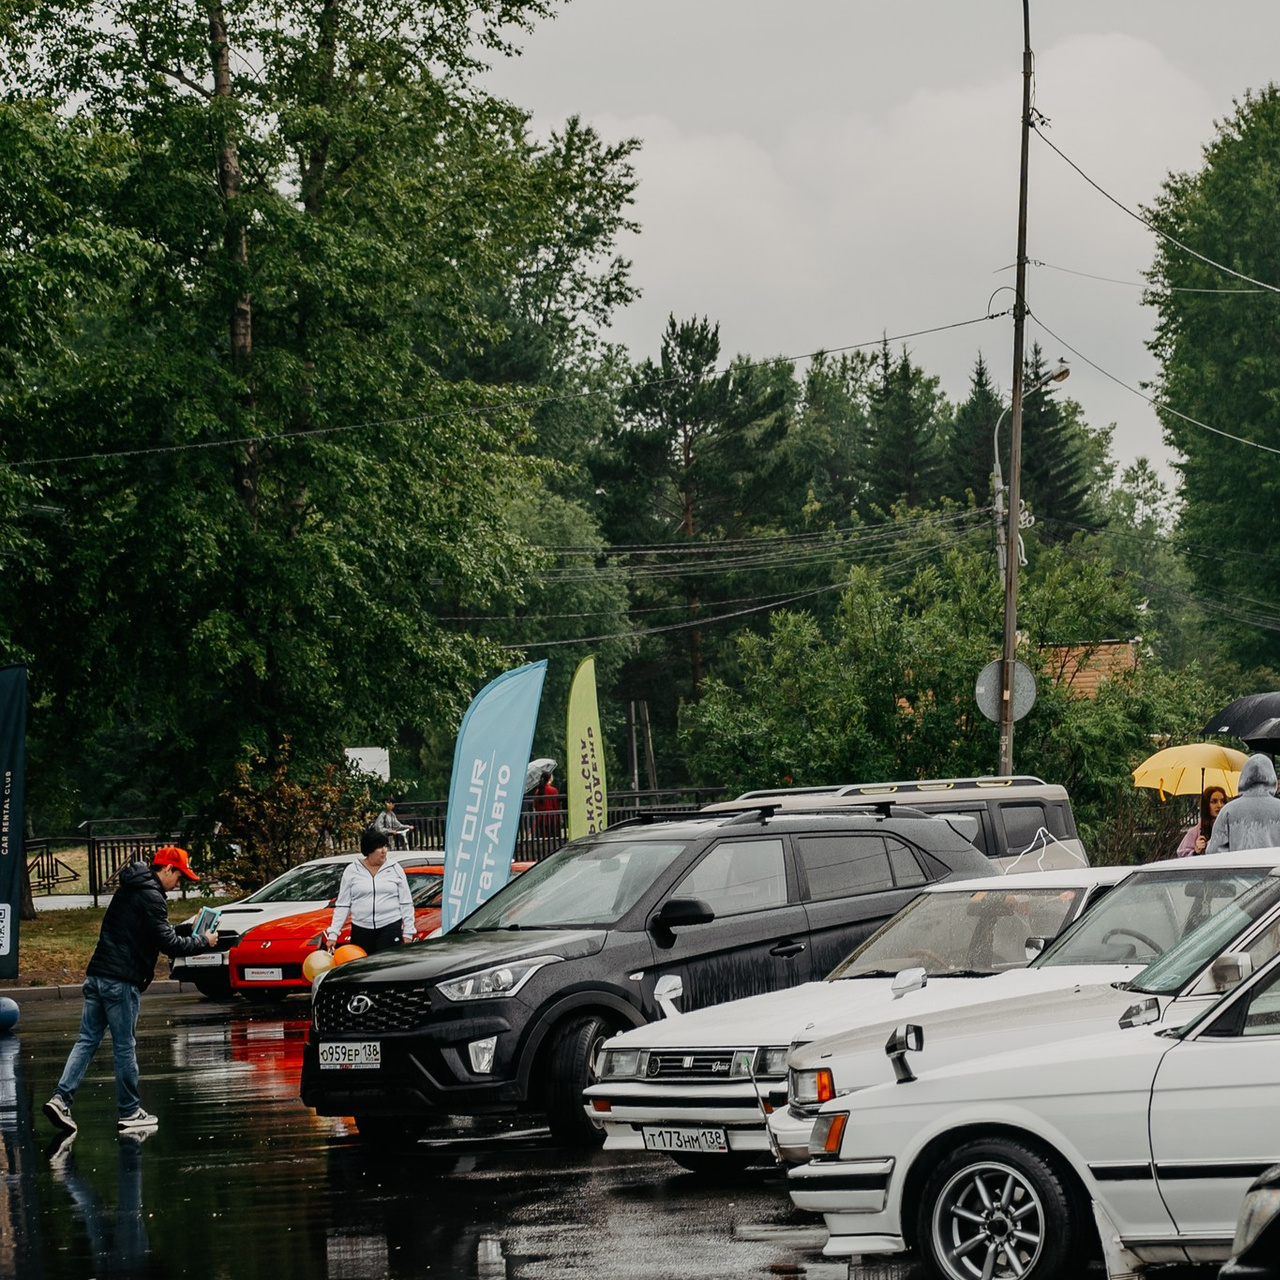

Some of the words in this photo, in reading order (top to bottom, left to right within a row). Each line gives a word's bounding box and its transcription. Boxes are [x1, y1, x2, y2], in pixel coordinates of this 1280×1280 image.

[4, 771, 12, 795] CLUB
[2, 797, 10, 834] RENTAL
[1, 834, 9, 855] CAR
[447, 758, 488, 925] JETOUR
[322, 1045, 360, 1061] О959ЕР
[362, 1044, 378, 1057] 138
[649, 1130, 701, 1149] Т173НМ
[701, 1131, 722, 1145] 138
